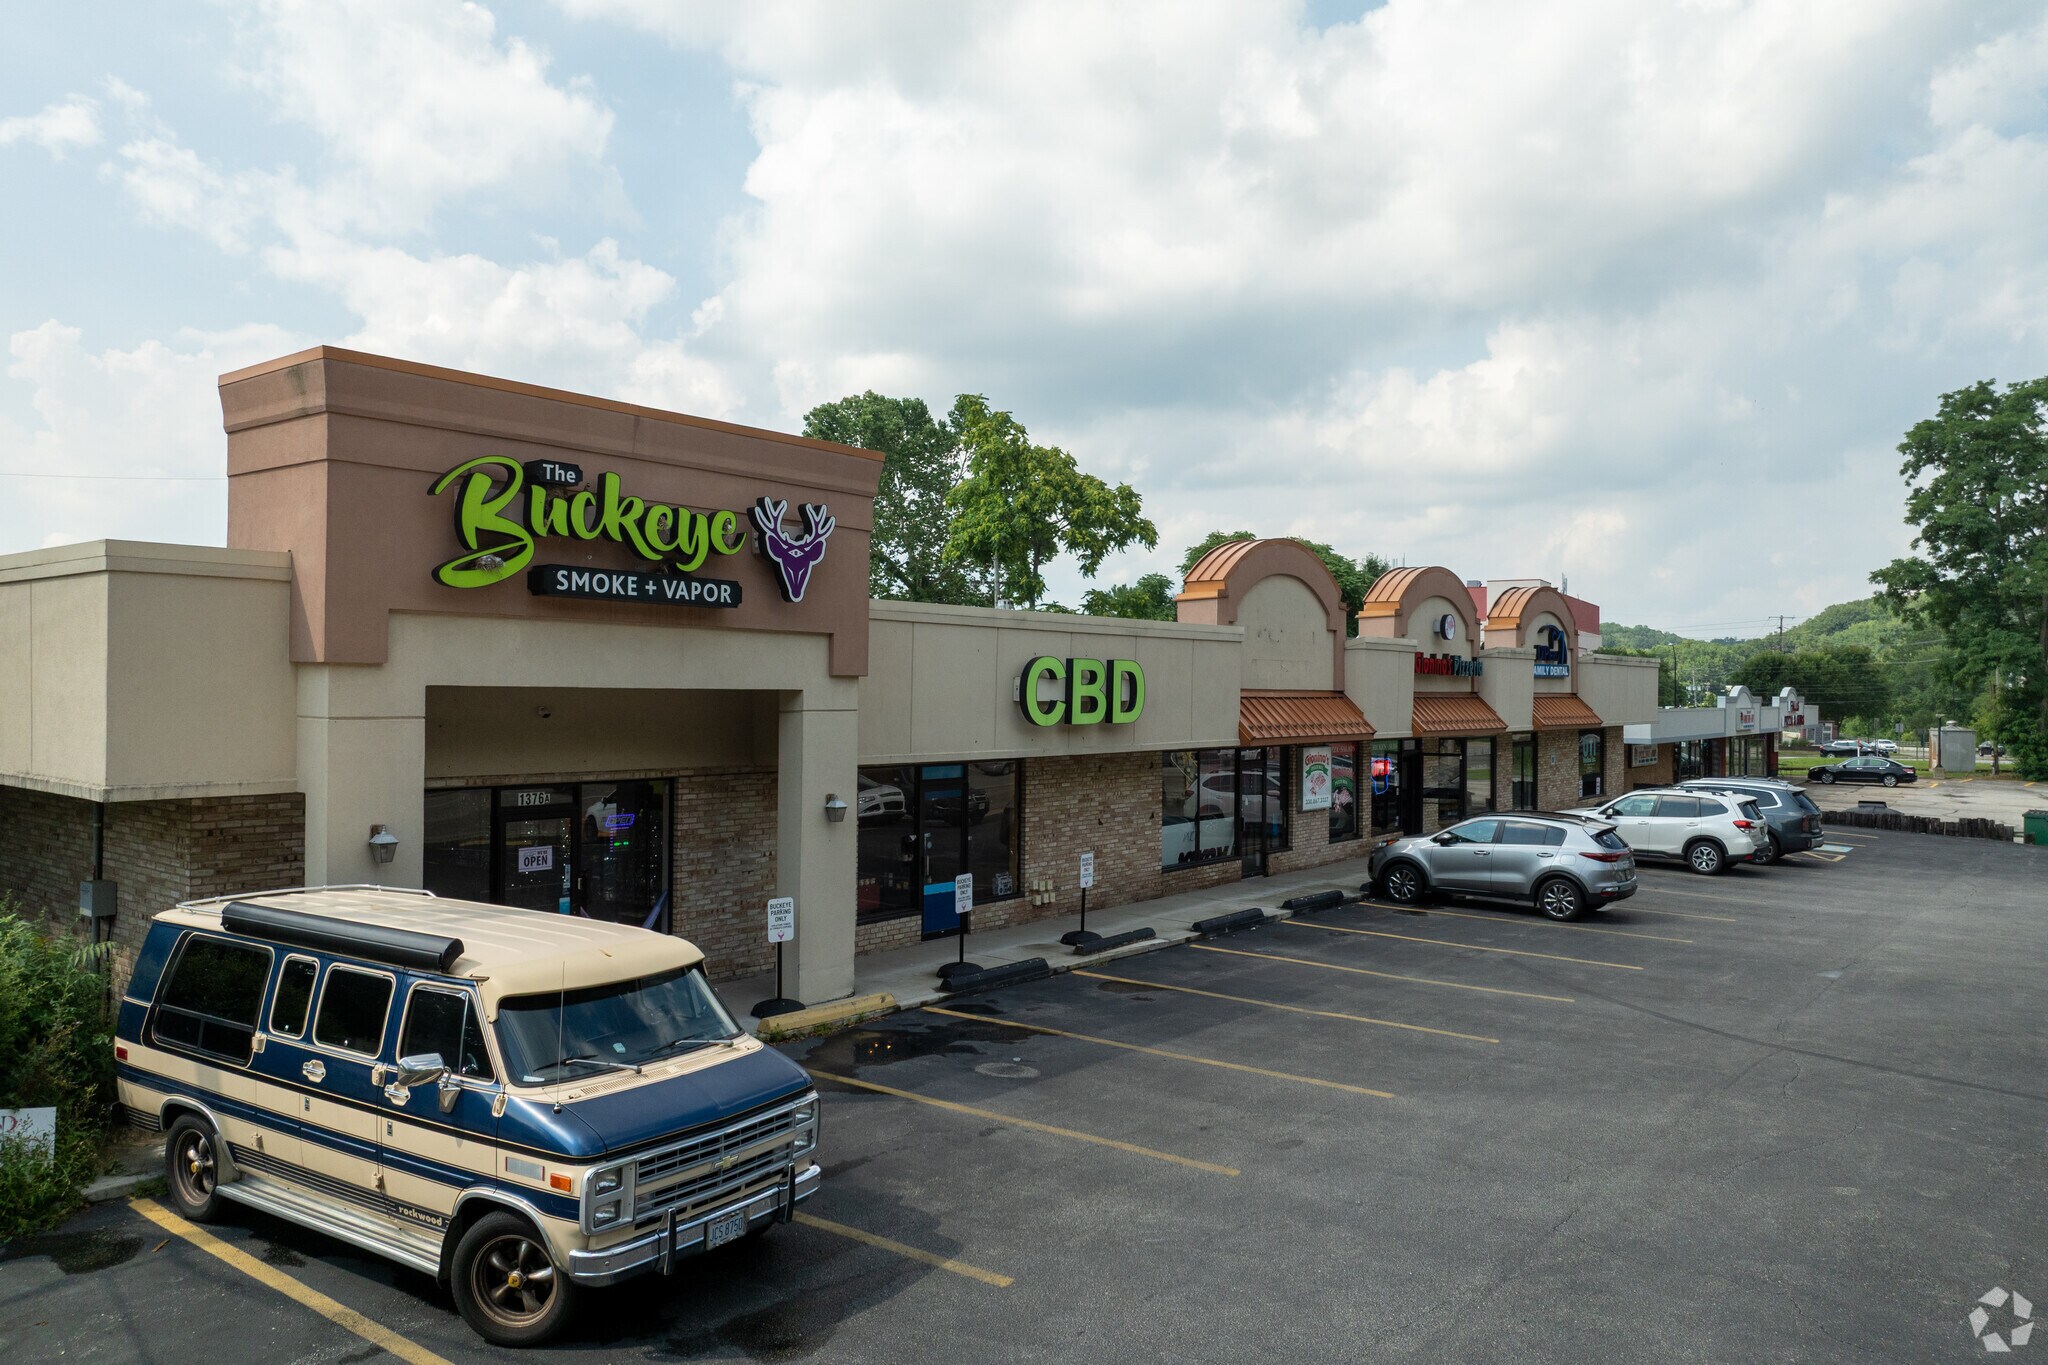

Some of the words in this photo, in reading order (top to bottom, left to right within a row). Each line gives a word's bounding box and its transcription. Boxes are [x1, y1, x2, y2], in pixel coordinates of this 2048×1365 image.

[542, 463, 577, 484] The
[430, 455, 747, 589] Buckeye
[556, 570, 638, 597] SMOKE
[645, 580, 658, 595] +
[663, 578, 732, 604] VAPOR
[1534, 665, 1550, 676] AMILY
[1550, 666, 1569, 676] DENTAL
[1021, 655, 1145, 727] CBD
[520, 792, 550, 806] 1376A
[523, 855, 548, 867] OPEN
[770, 901, 792, 910] BUCKEYE
[770, 908, 792, 916] PARKING
[398, 1206, 443, 1227] rockwood
[710, 1224, 723, 1242] JCS
[725, 1216, 743, 1236] 8750
